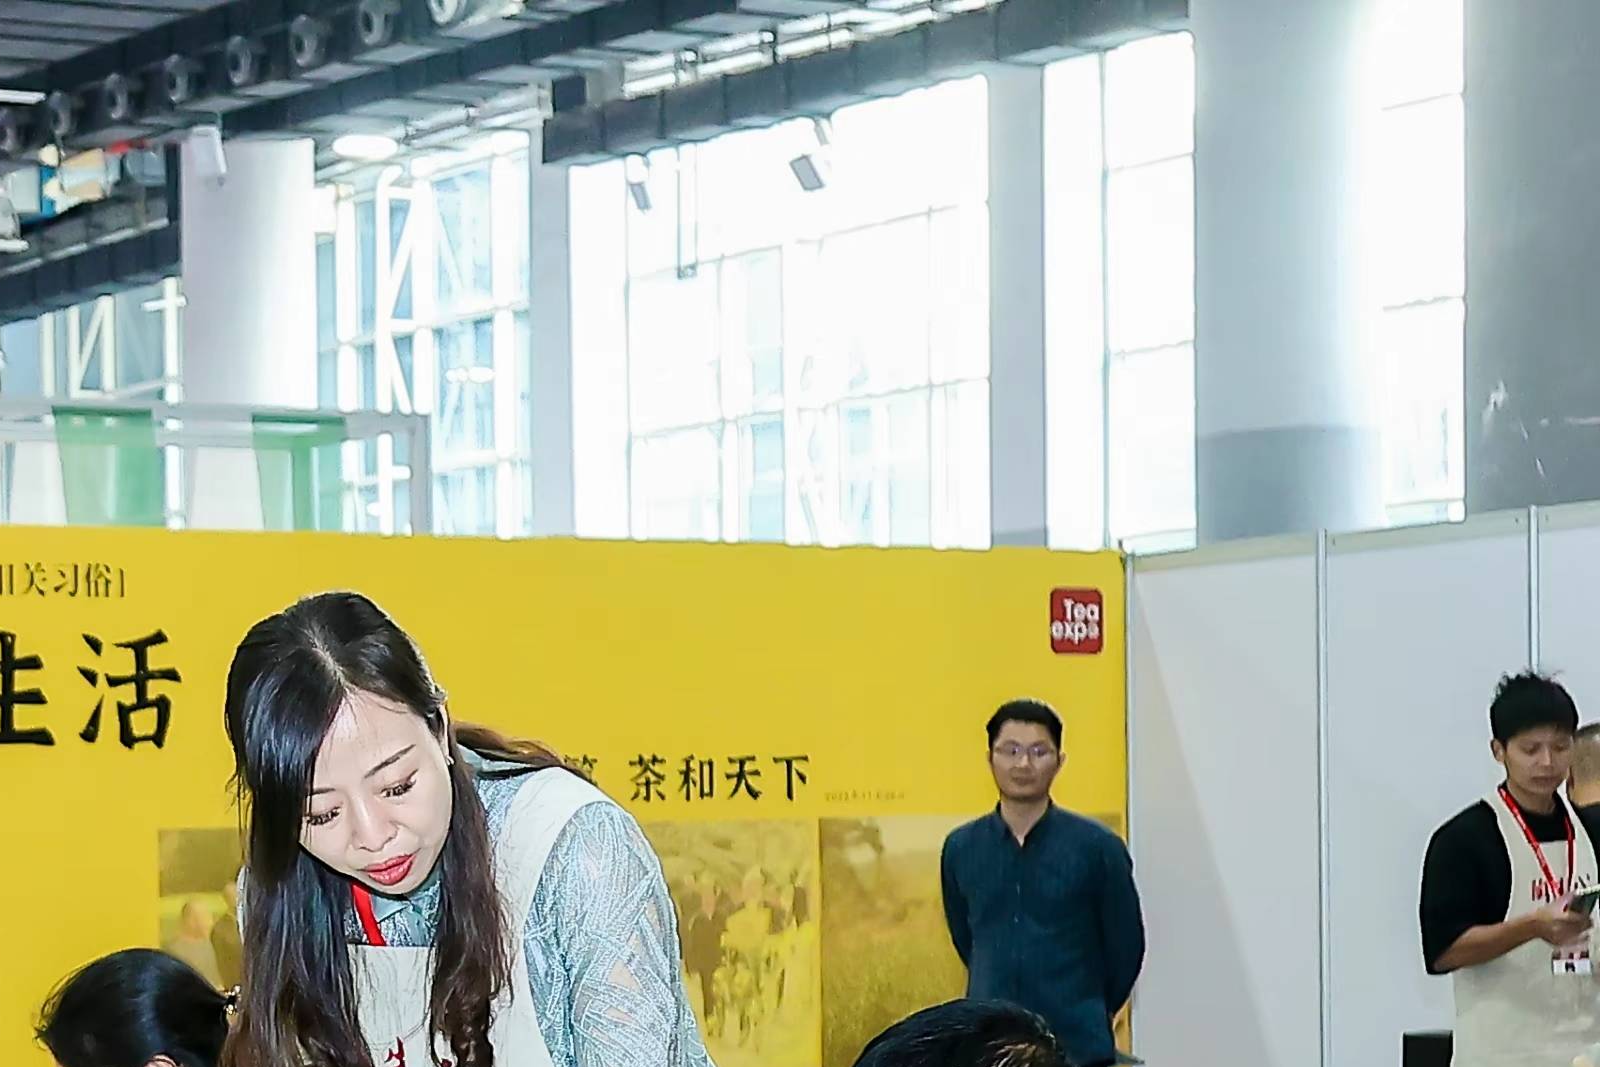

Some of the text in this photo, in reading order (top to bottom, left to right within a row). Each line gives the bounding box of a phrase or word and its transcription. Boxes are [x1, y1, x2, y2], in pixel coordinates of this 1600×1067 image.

[1063, 597, 1100, 622] Tea
[628, 753, 811, 803] 茶和天下
